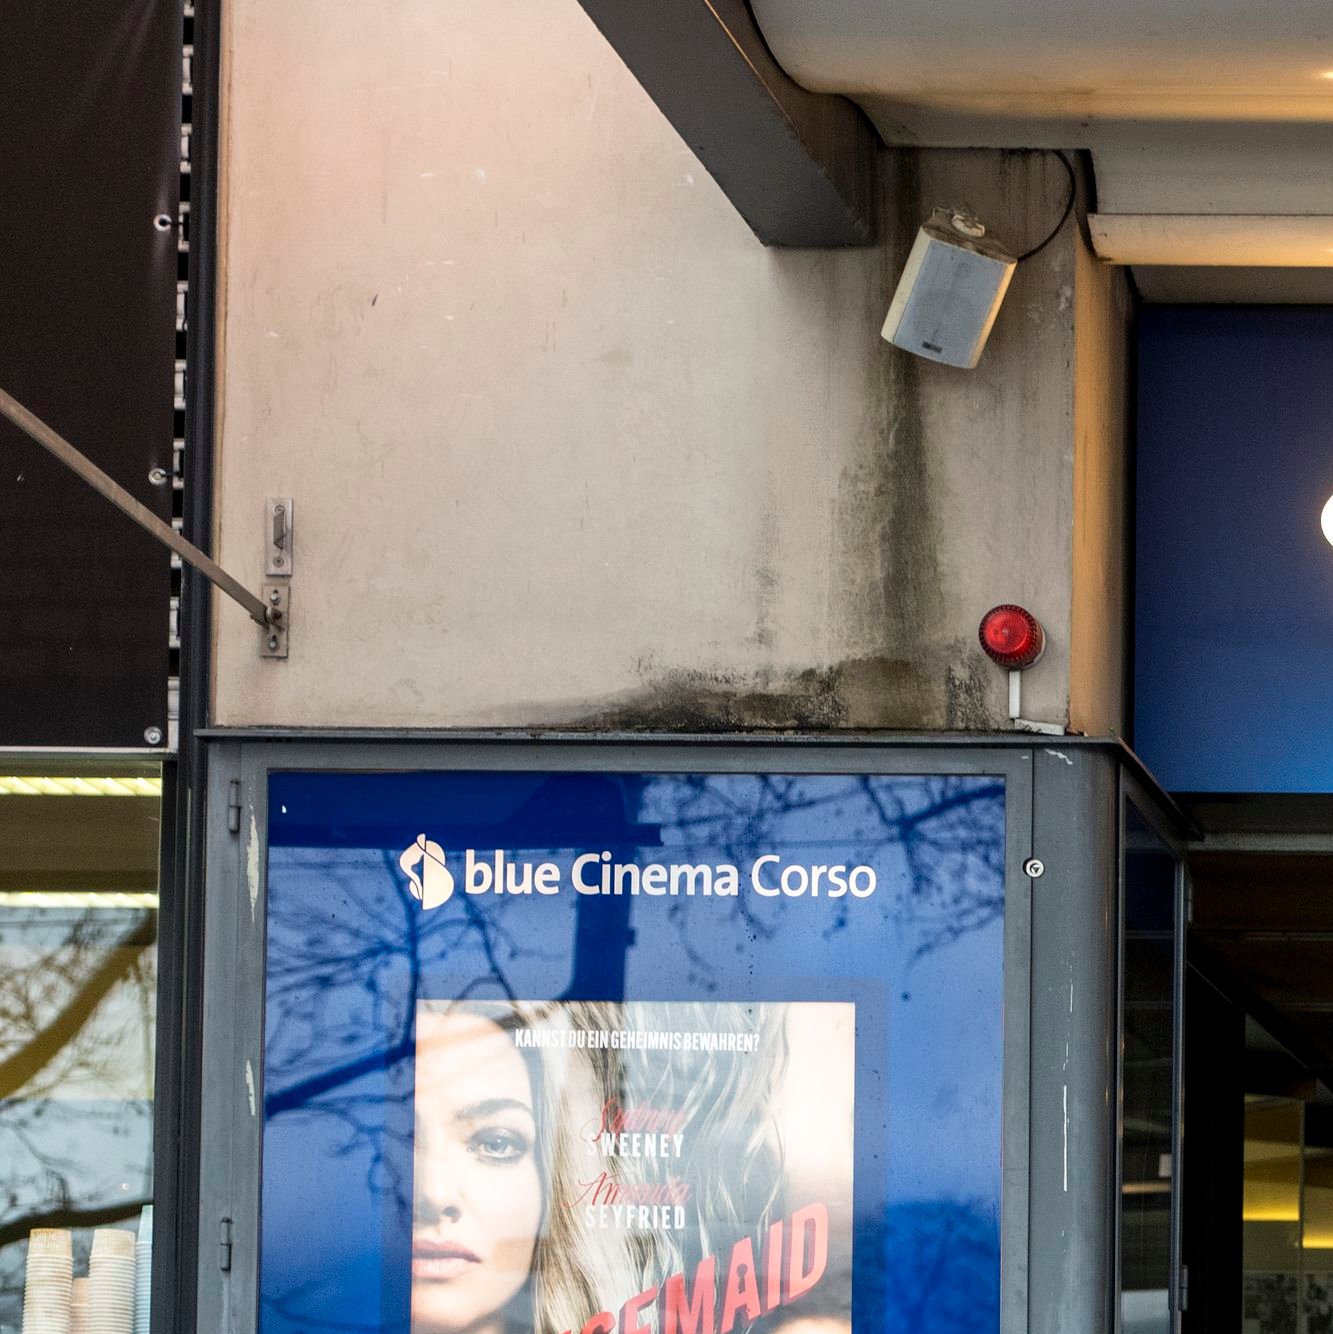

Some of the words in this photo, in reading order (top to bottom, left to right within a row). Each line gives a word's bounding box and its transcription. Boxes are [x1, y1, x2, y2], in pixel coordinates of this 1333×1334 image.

[465, 849, 560, 895] blue
[571, 851, 739, 897] Cinema
[751, 854, 877, 898] Corso
[515, 1028, 566, 1048] KANNST
[568, 1030, 585, 1048] DU
[587, 1030, 608, 1048] EIN
[610, 1031, 681, 1050] GEHEIMNIS
[684, 1032, 760, 1052] BEWAHREN?
[586, 1132, 684, 1158] SWEENEY
[585, 1205, 686, 1230] SEYFRIED
